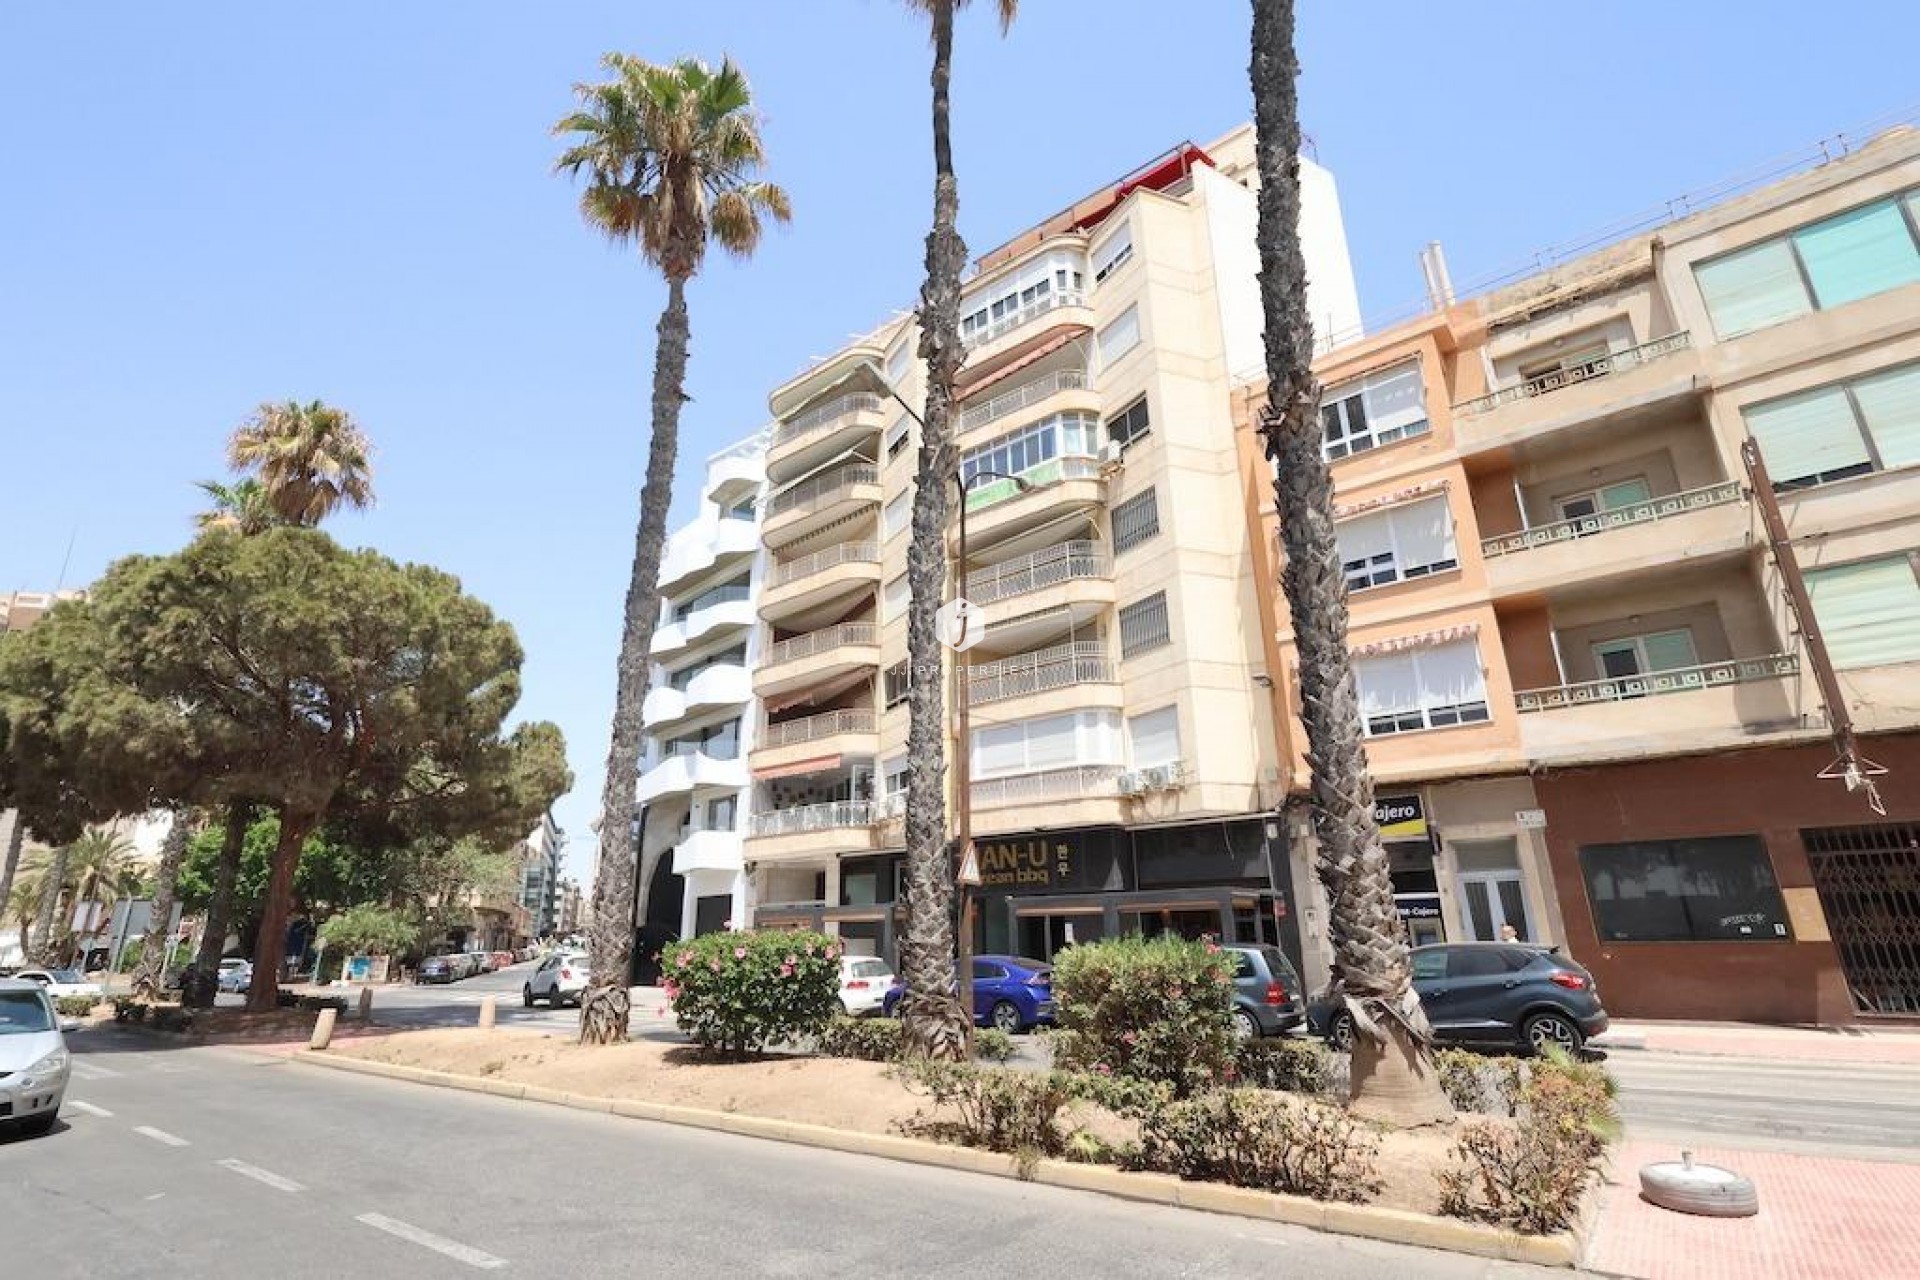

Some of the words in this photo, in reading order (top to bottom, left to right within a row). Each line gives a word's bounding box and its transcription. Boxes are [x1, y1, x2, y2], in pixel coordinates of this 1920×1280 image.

[1375, 805, 1415, 821] ajero
[980, 841, 1047, 870] AN-U
[1018, 868, 1049, 884] bbq
